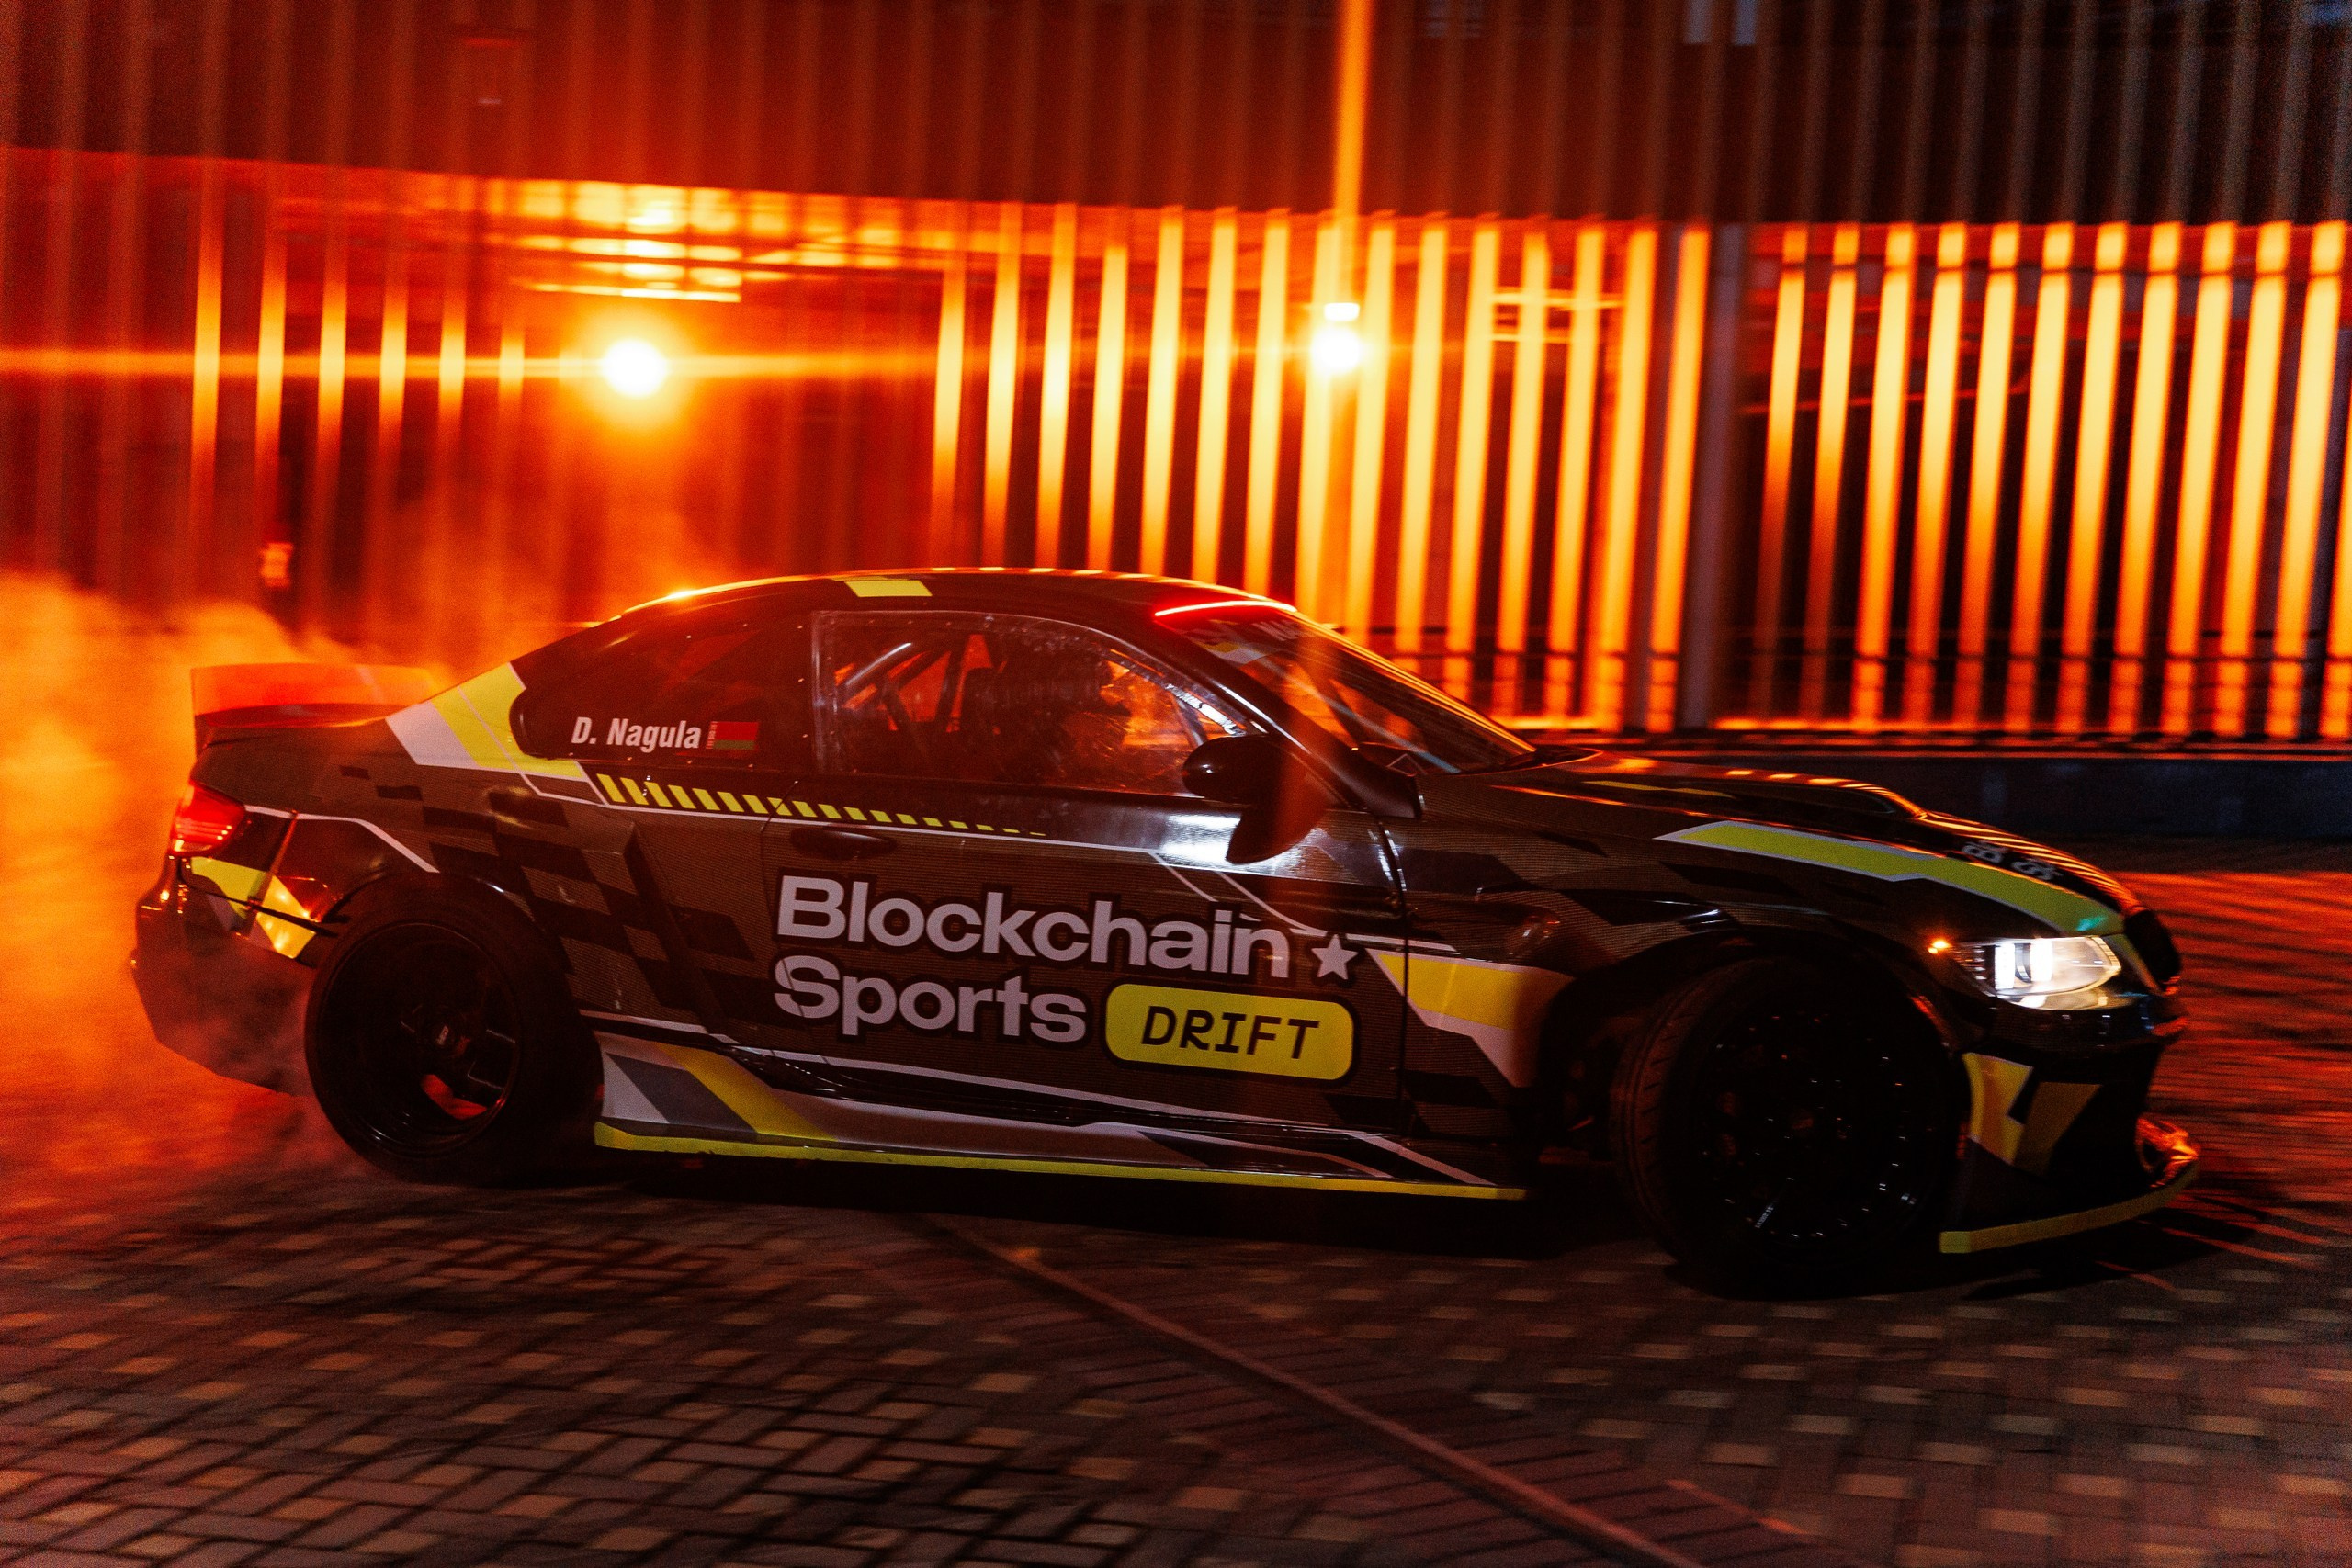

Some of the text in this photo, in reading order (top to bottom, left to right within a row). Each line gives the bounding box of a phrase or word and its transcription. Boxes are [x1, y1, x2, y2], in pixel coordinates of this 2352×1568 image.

[571, 716, 702, 754] D. Nagula
[776, 874, 1290, 979] Blockchain
[773, 955, 1087, 1043] Sports
[1141, 1005, 1319, 1059] DRIFT
